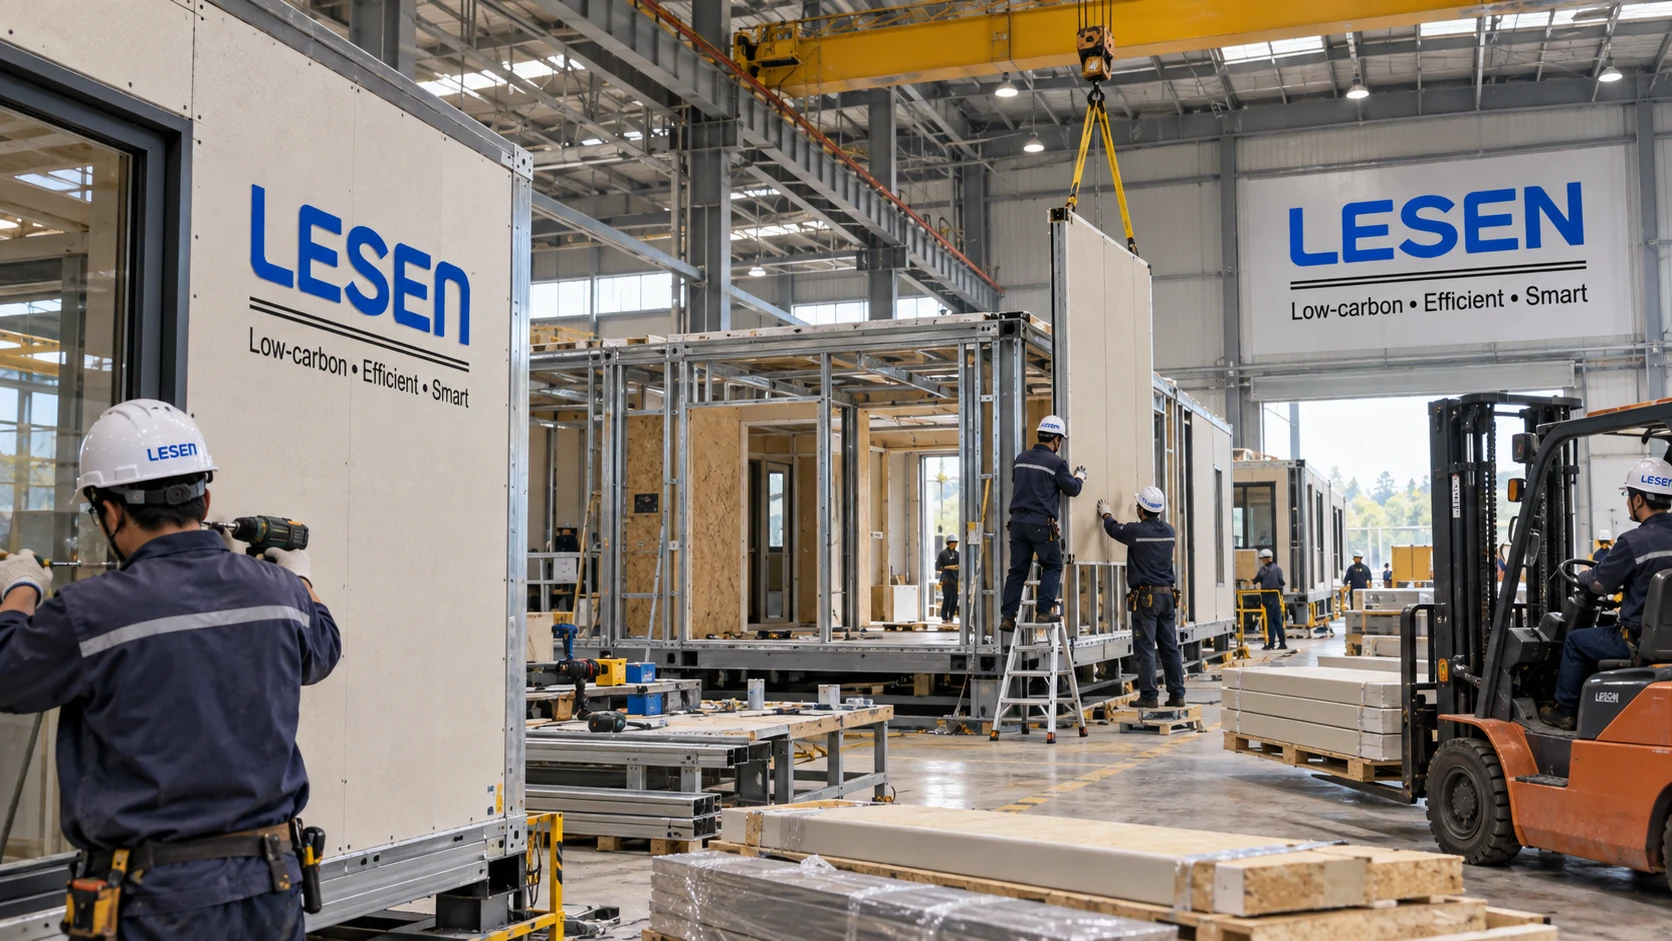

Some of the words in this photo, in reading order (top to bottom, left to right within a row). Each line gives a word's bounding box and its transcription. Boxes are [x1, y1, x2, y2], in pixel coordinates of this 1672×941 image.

[1289, 181, 1585, 267] LESEN
[1291, 297, 1403, 320] Low-carbon
[1424, 289, 1505, 312] Efficient
[1525, 284, 1588, 306] Smart
[249, 326, 348, 377] Low-carbon
[362, 358, 419, 396] Efficient
[432, 379, 469, 408] Smart
